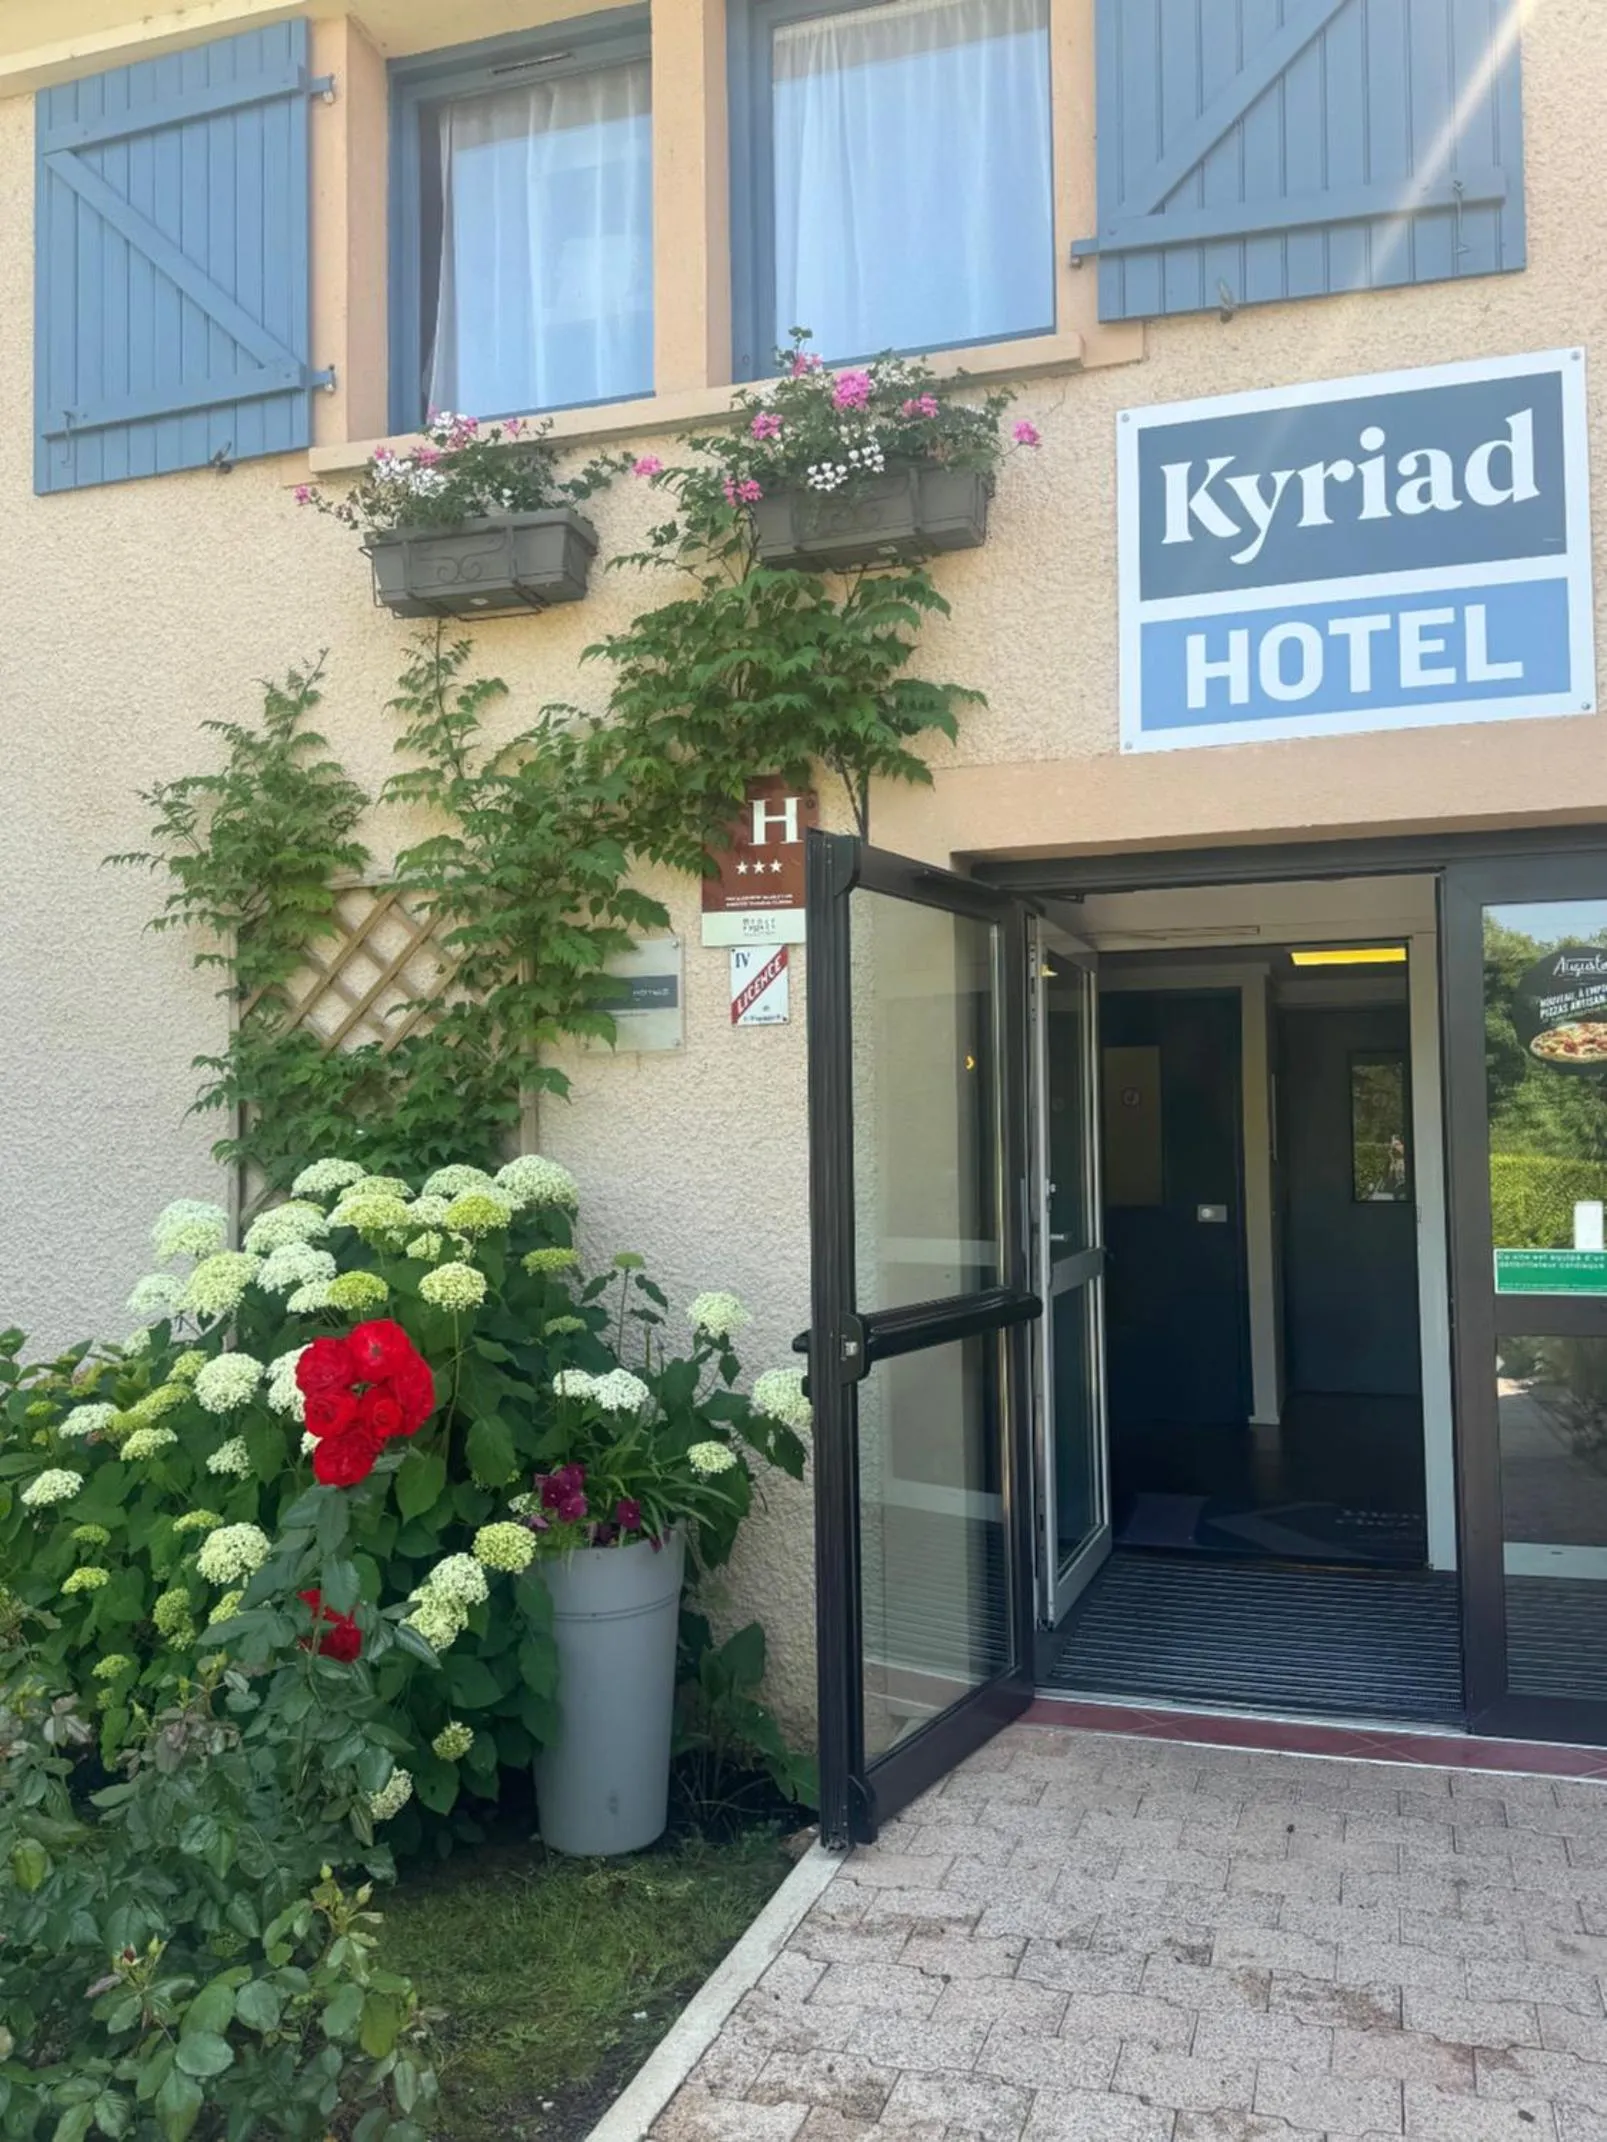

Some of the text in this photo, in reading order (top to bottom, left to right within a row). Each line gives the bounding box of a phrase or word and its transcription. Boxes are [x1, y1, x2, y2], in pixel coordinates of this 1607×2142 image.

[1160, 408, 1540, 565] Kyriad
[1186, 604, 1524, 709] HOTEL
[749, 797, 803, 846] H
[735, 952, 751, 968] IV
[736, 954, 783, 1014] LICENCE
